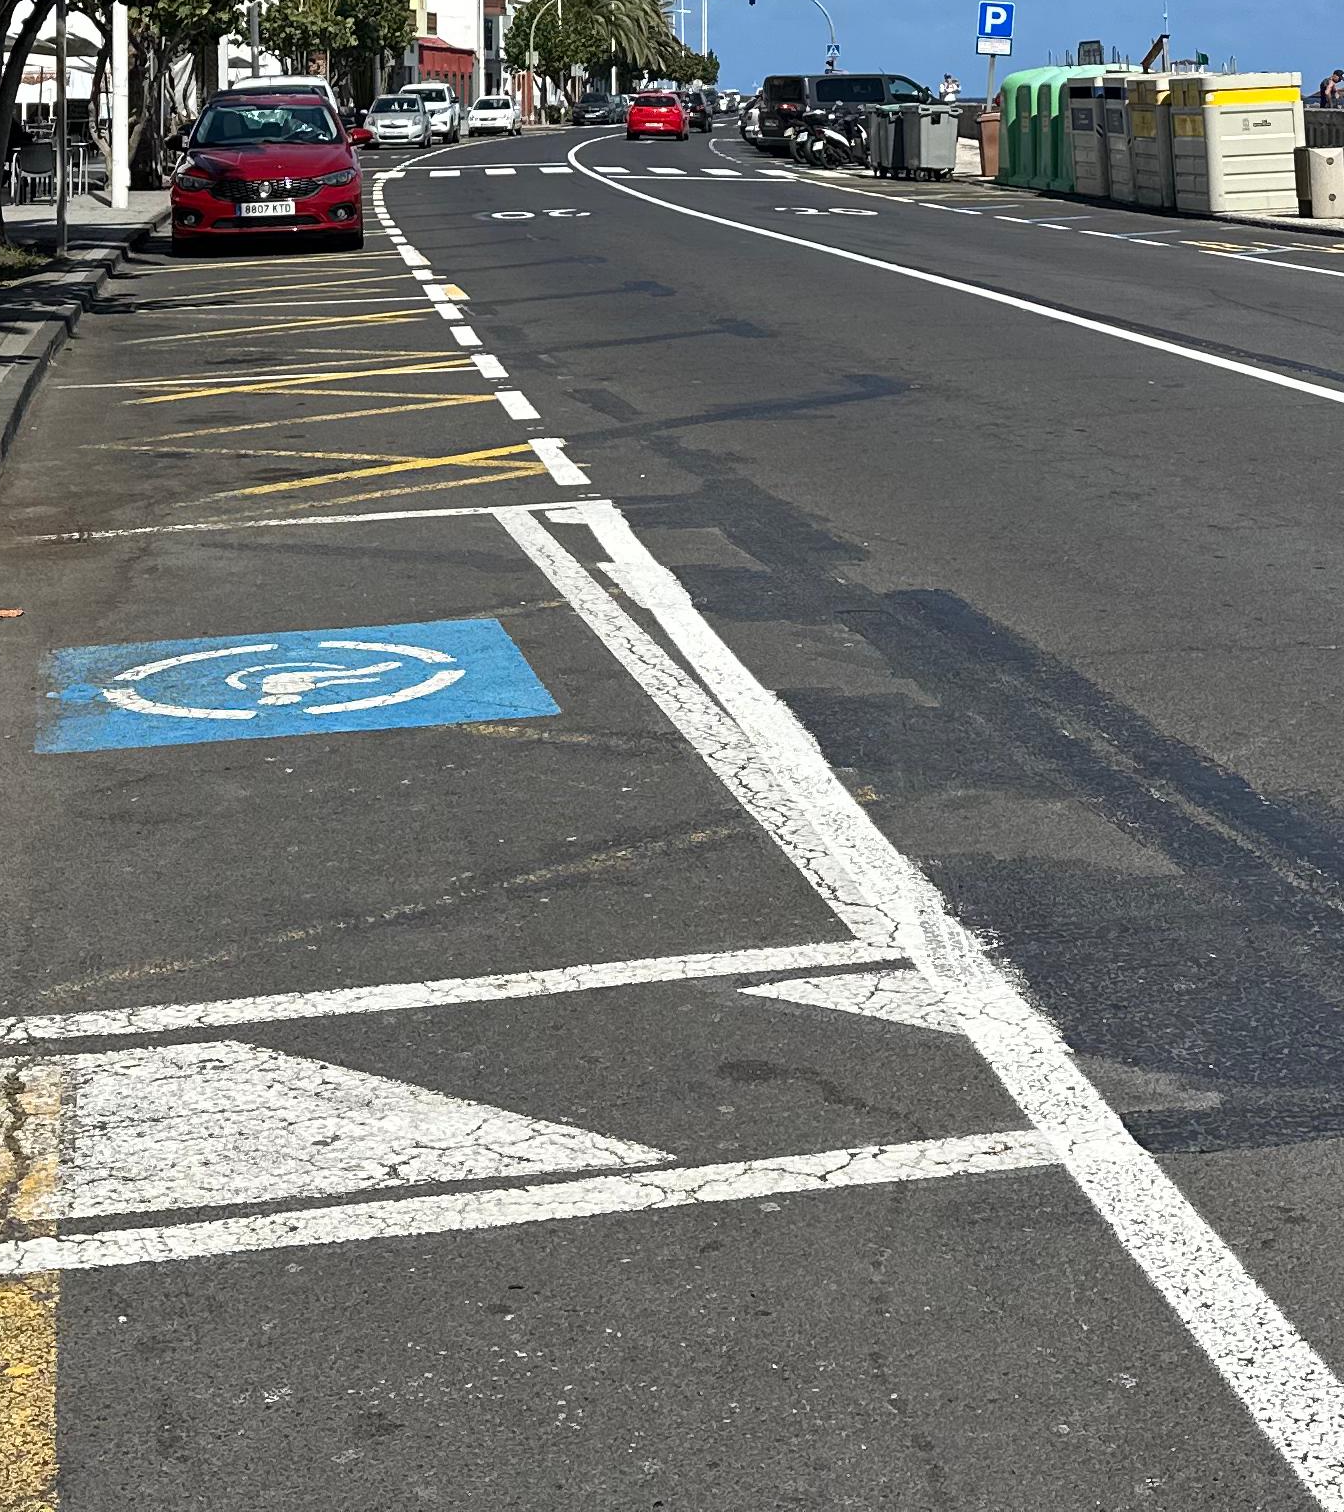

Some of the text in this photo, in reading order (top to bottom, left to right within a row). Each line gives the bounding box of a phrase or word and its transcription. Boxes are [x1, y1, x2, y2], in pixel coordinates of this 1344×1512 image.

[984, 5, 1008, 34] P
[245, 203, 291, 215] 8807 KTD
[774, 207, 879, 216] 20
